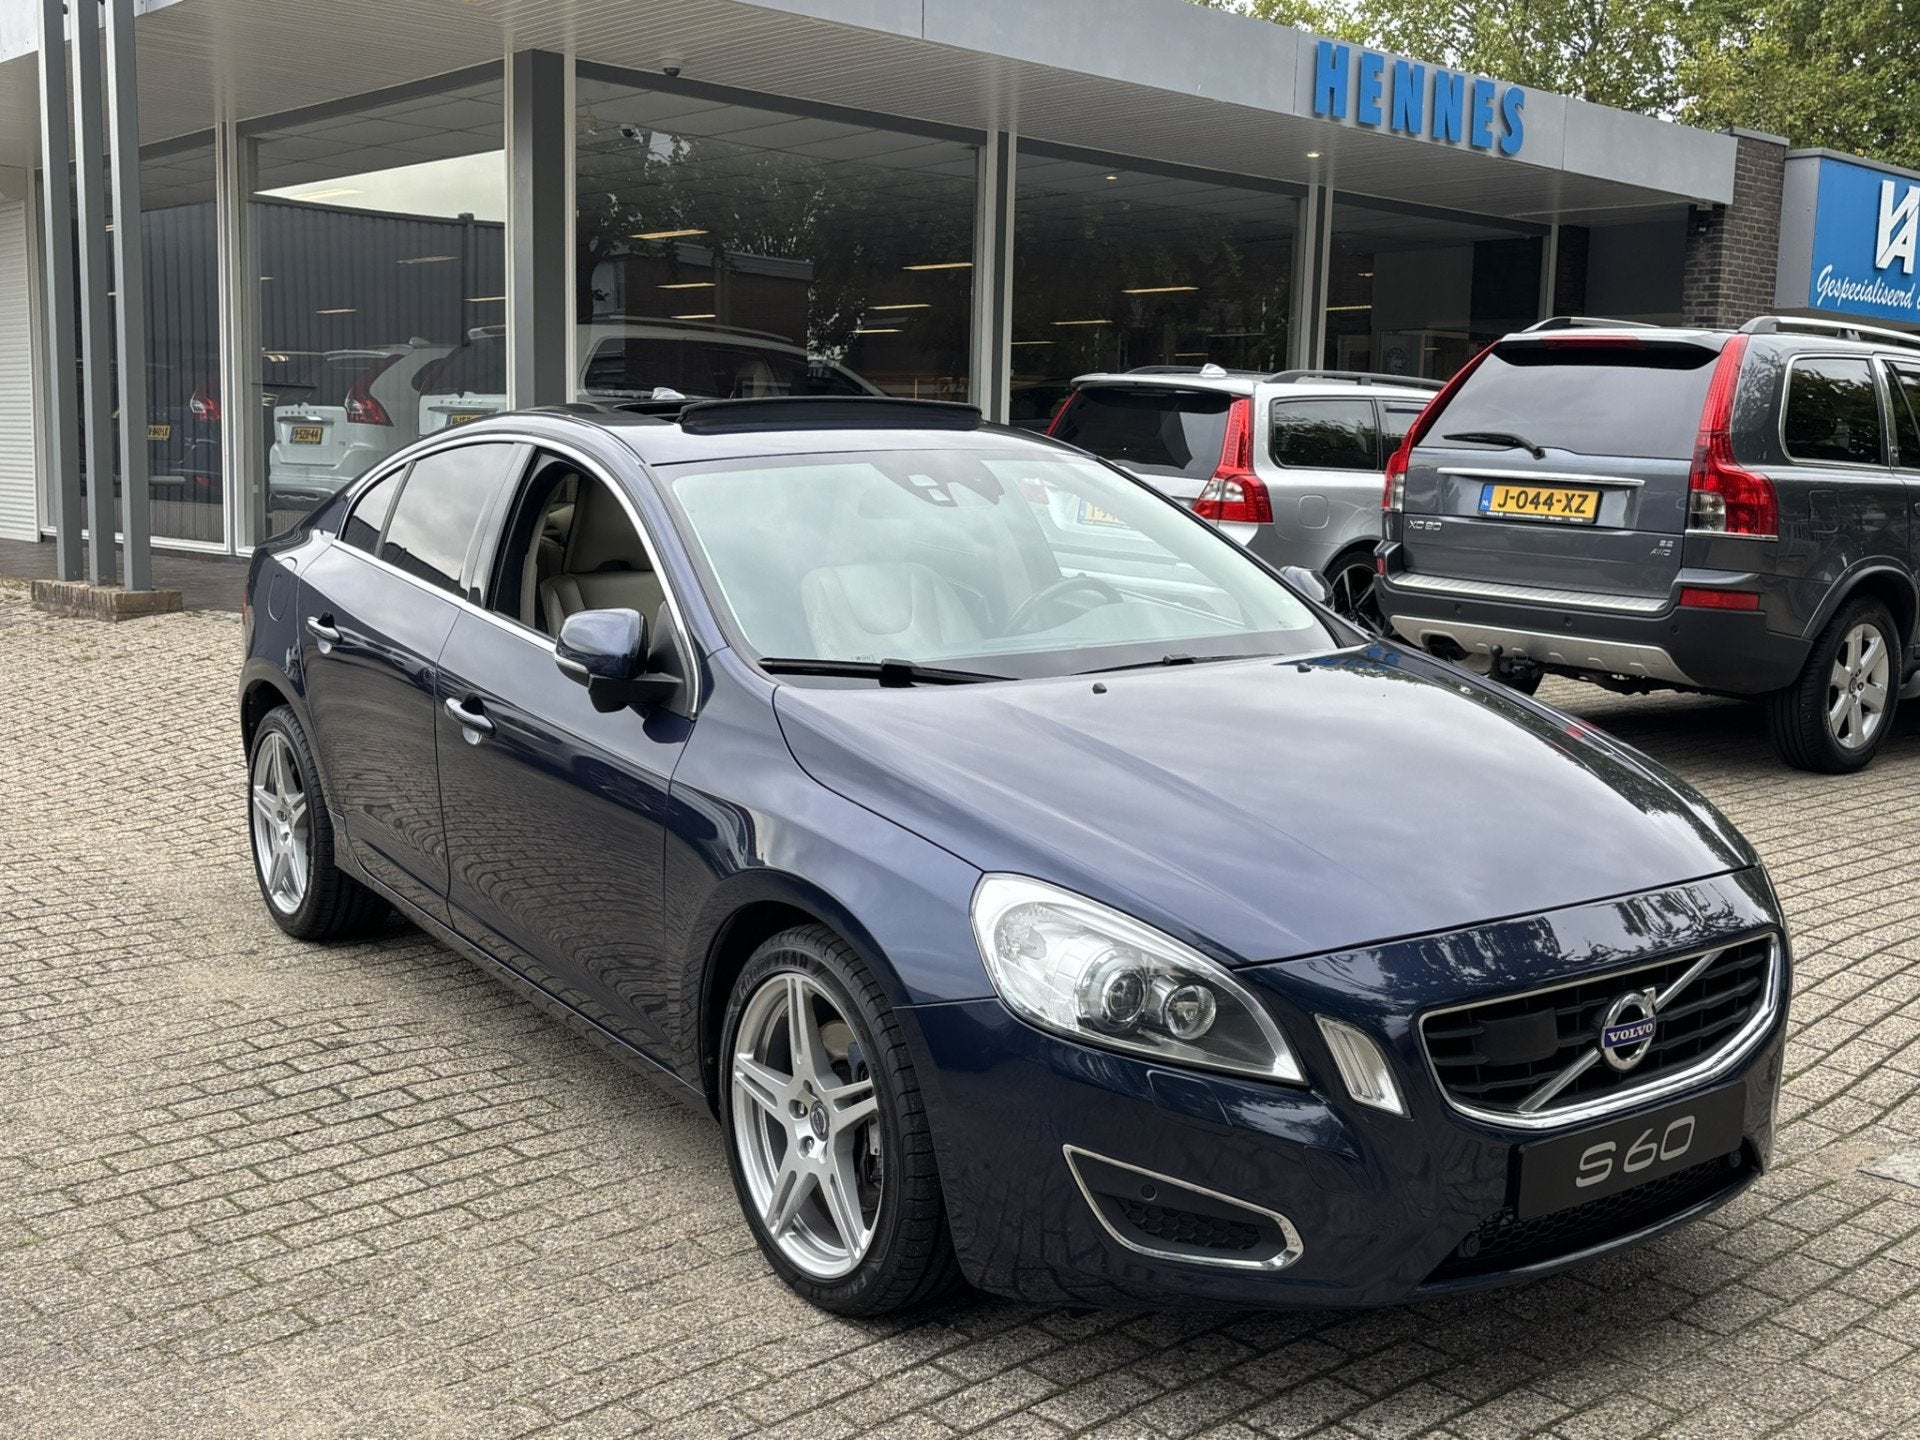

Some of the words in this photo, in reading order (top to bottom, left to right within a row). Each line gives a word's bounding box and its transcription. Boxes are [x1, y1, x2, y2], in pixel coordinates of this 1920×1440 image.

[1315, 41, 1525, 155] HENNES
[1817, 264, 1913, 310] Gespecialiseerd
[1498, 489, 1589, 514] J-044-XZ
[1607, 1023, 1653, 1042] VOLVO
[1575, 1115, 1695, 1188] S60
